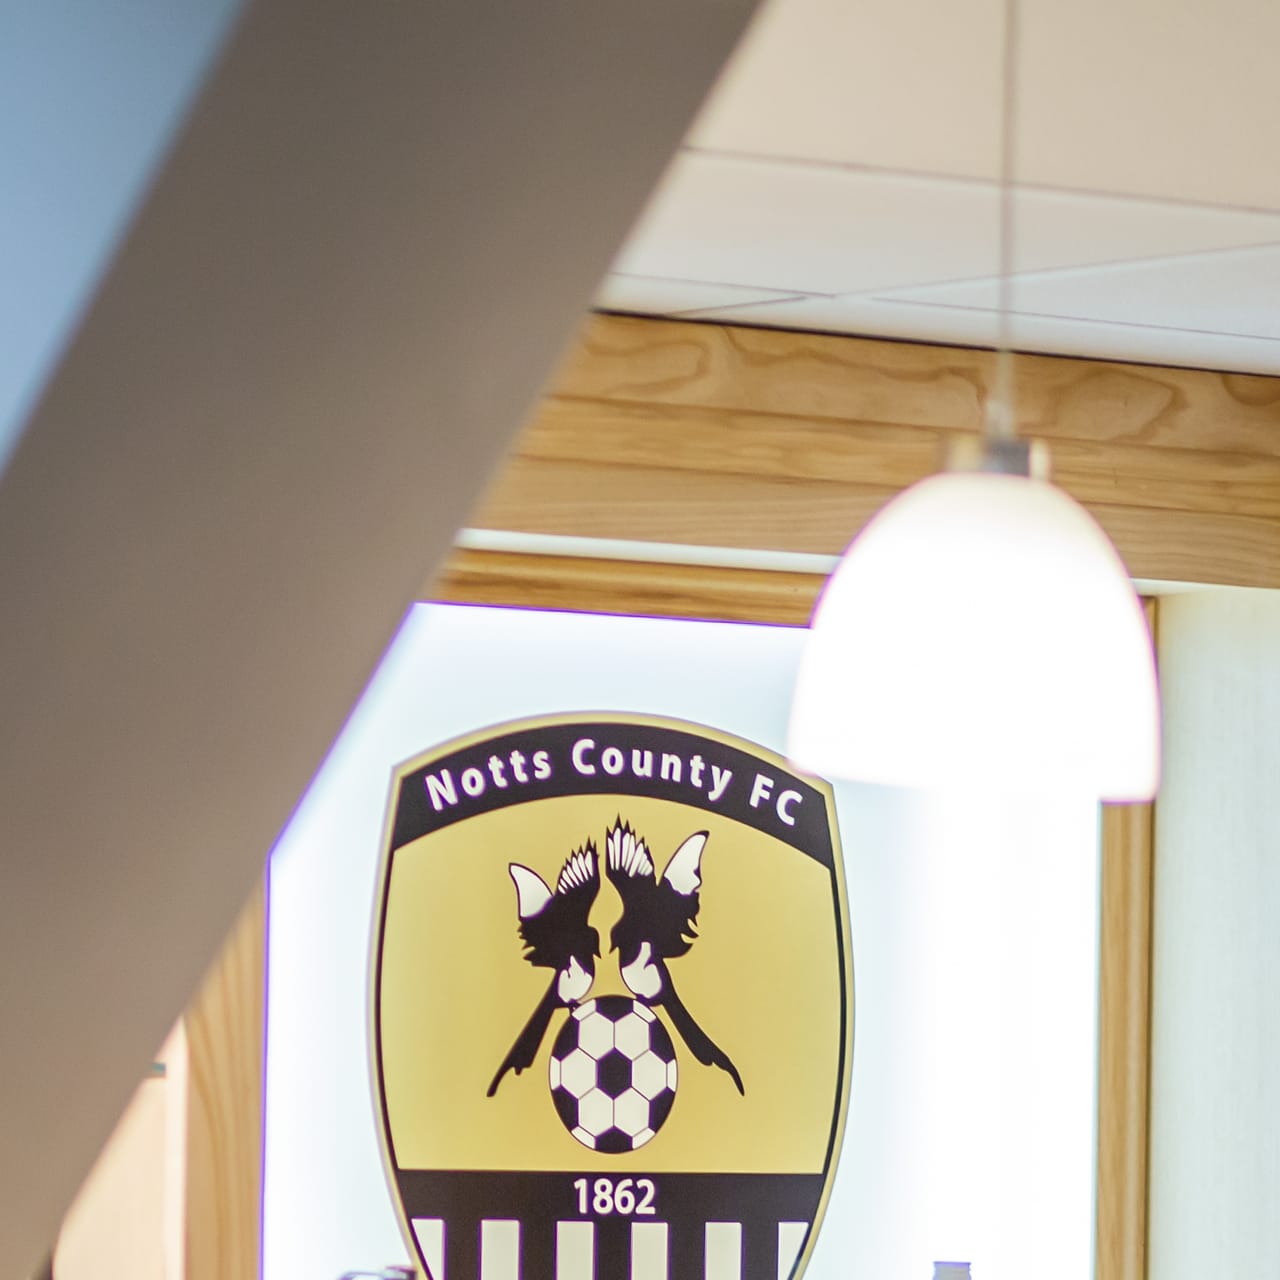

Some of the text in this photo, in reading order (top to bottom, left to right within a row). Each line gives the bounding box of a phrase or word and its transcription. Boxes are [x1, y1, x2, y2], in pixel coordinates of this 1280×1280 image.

[424, 738, 804, 827] Notts County FC
[573, 1177, 657, 1215] 1862
